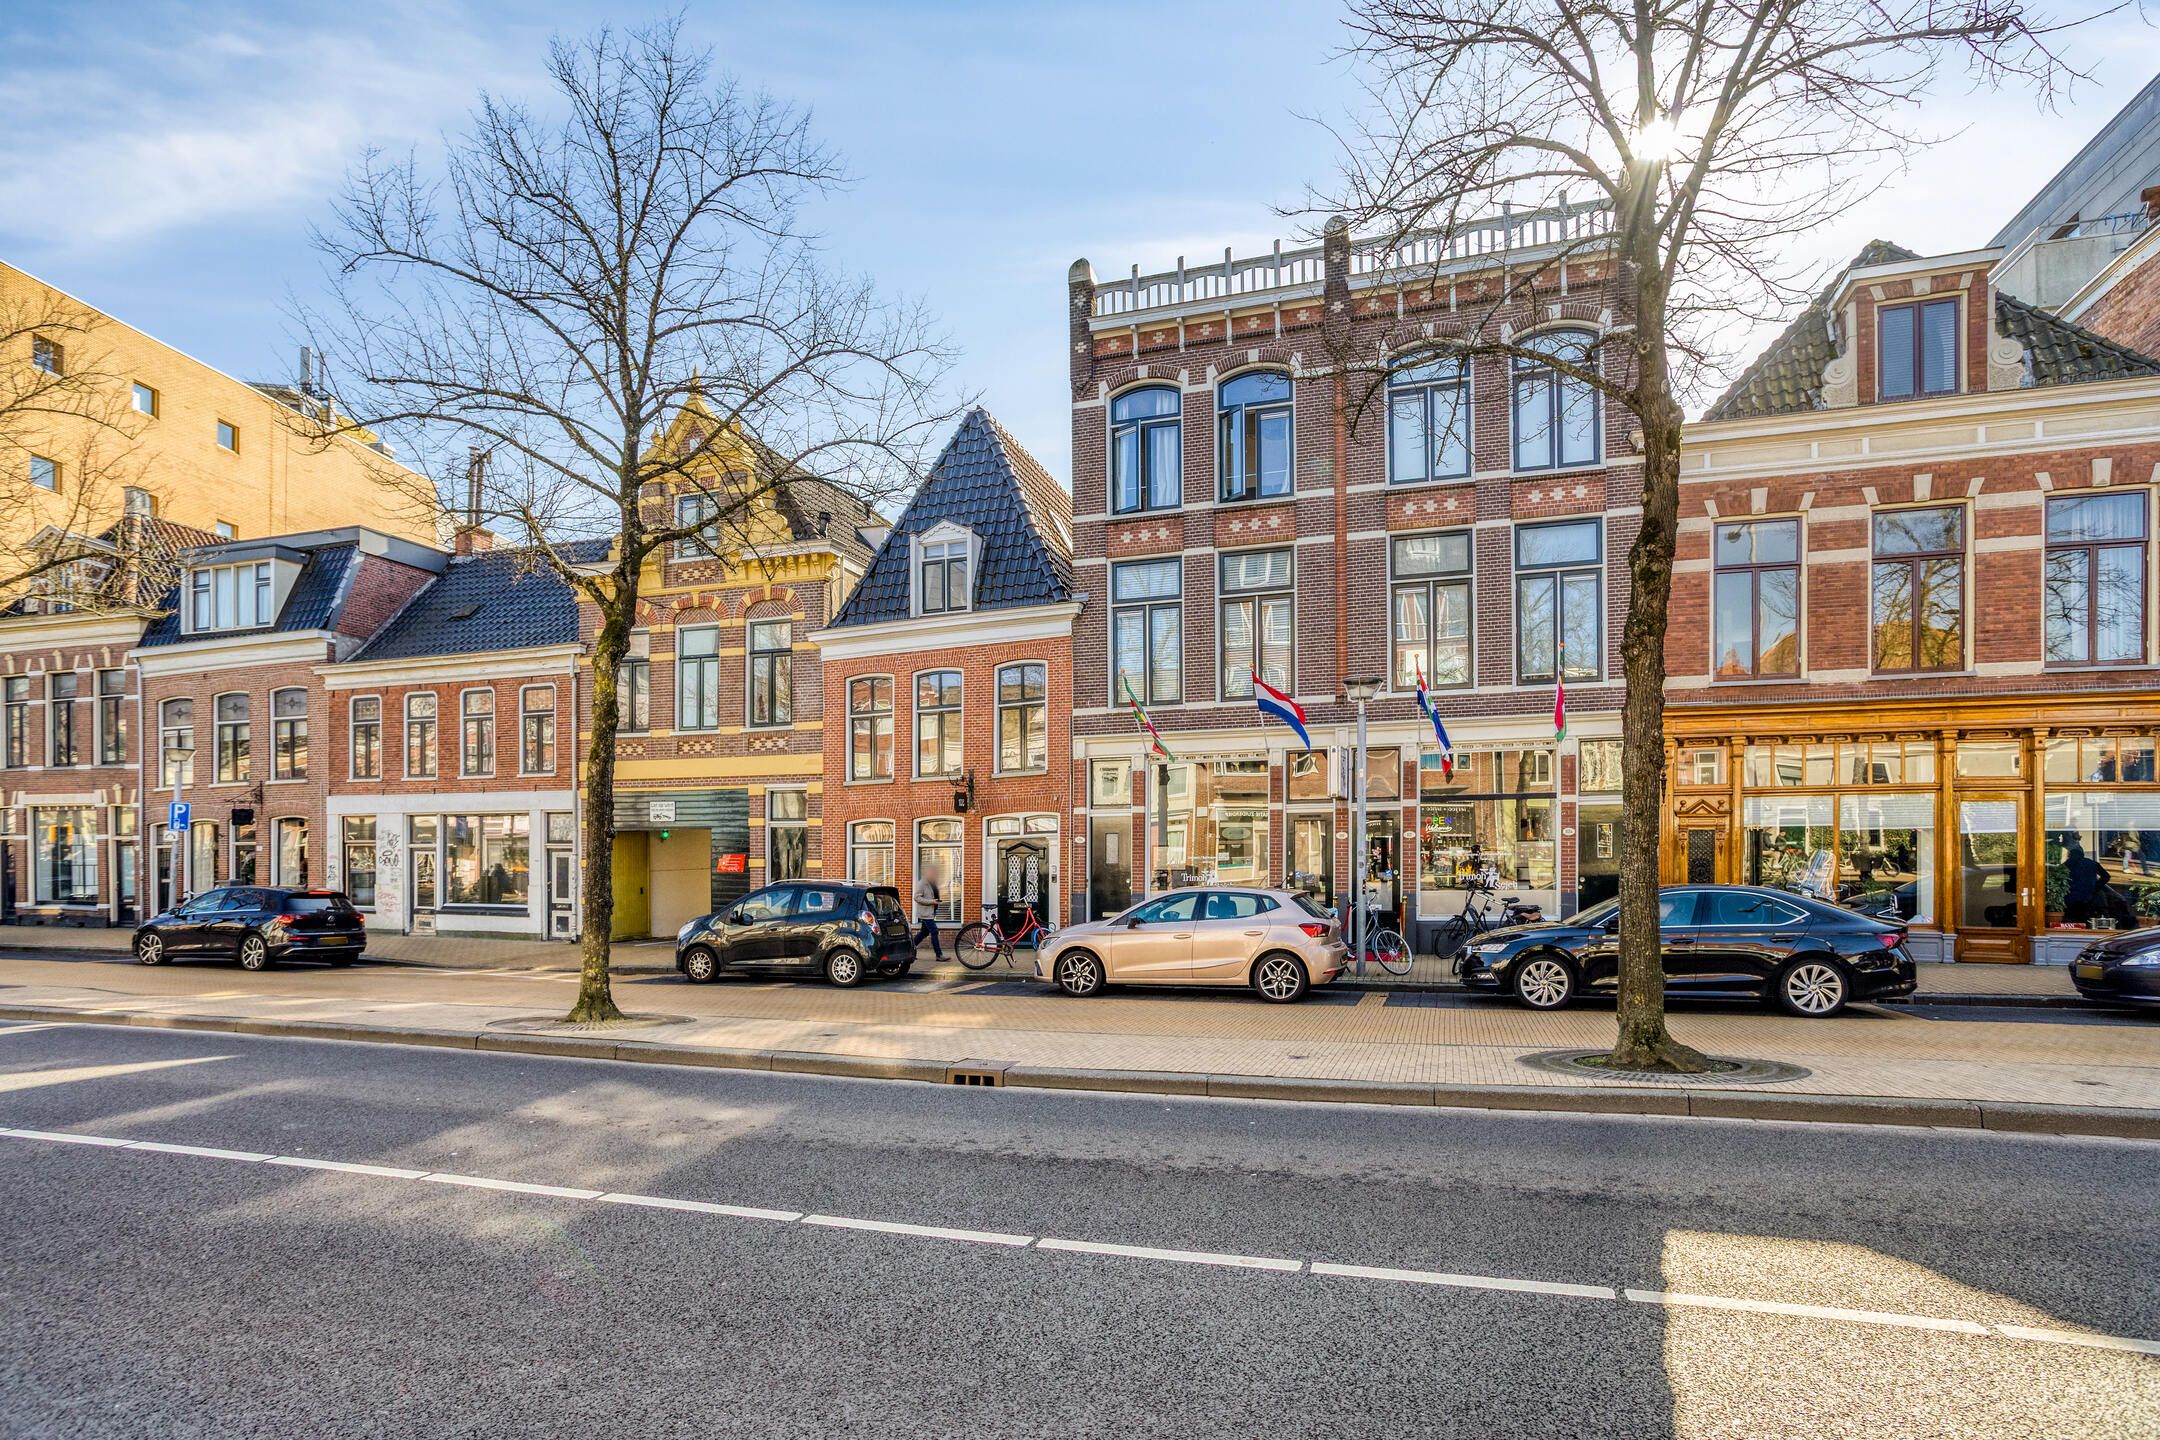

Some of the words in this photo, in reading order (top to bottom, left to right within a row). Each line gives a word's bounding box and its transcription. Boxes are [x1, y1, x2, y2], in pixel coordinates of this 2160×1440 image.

[174, 804, 187, 819] P
[1425, 816, 1453, 825] OPEN
[1181, 873, 1208, 881] Trimoh
